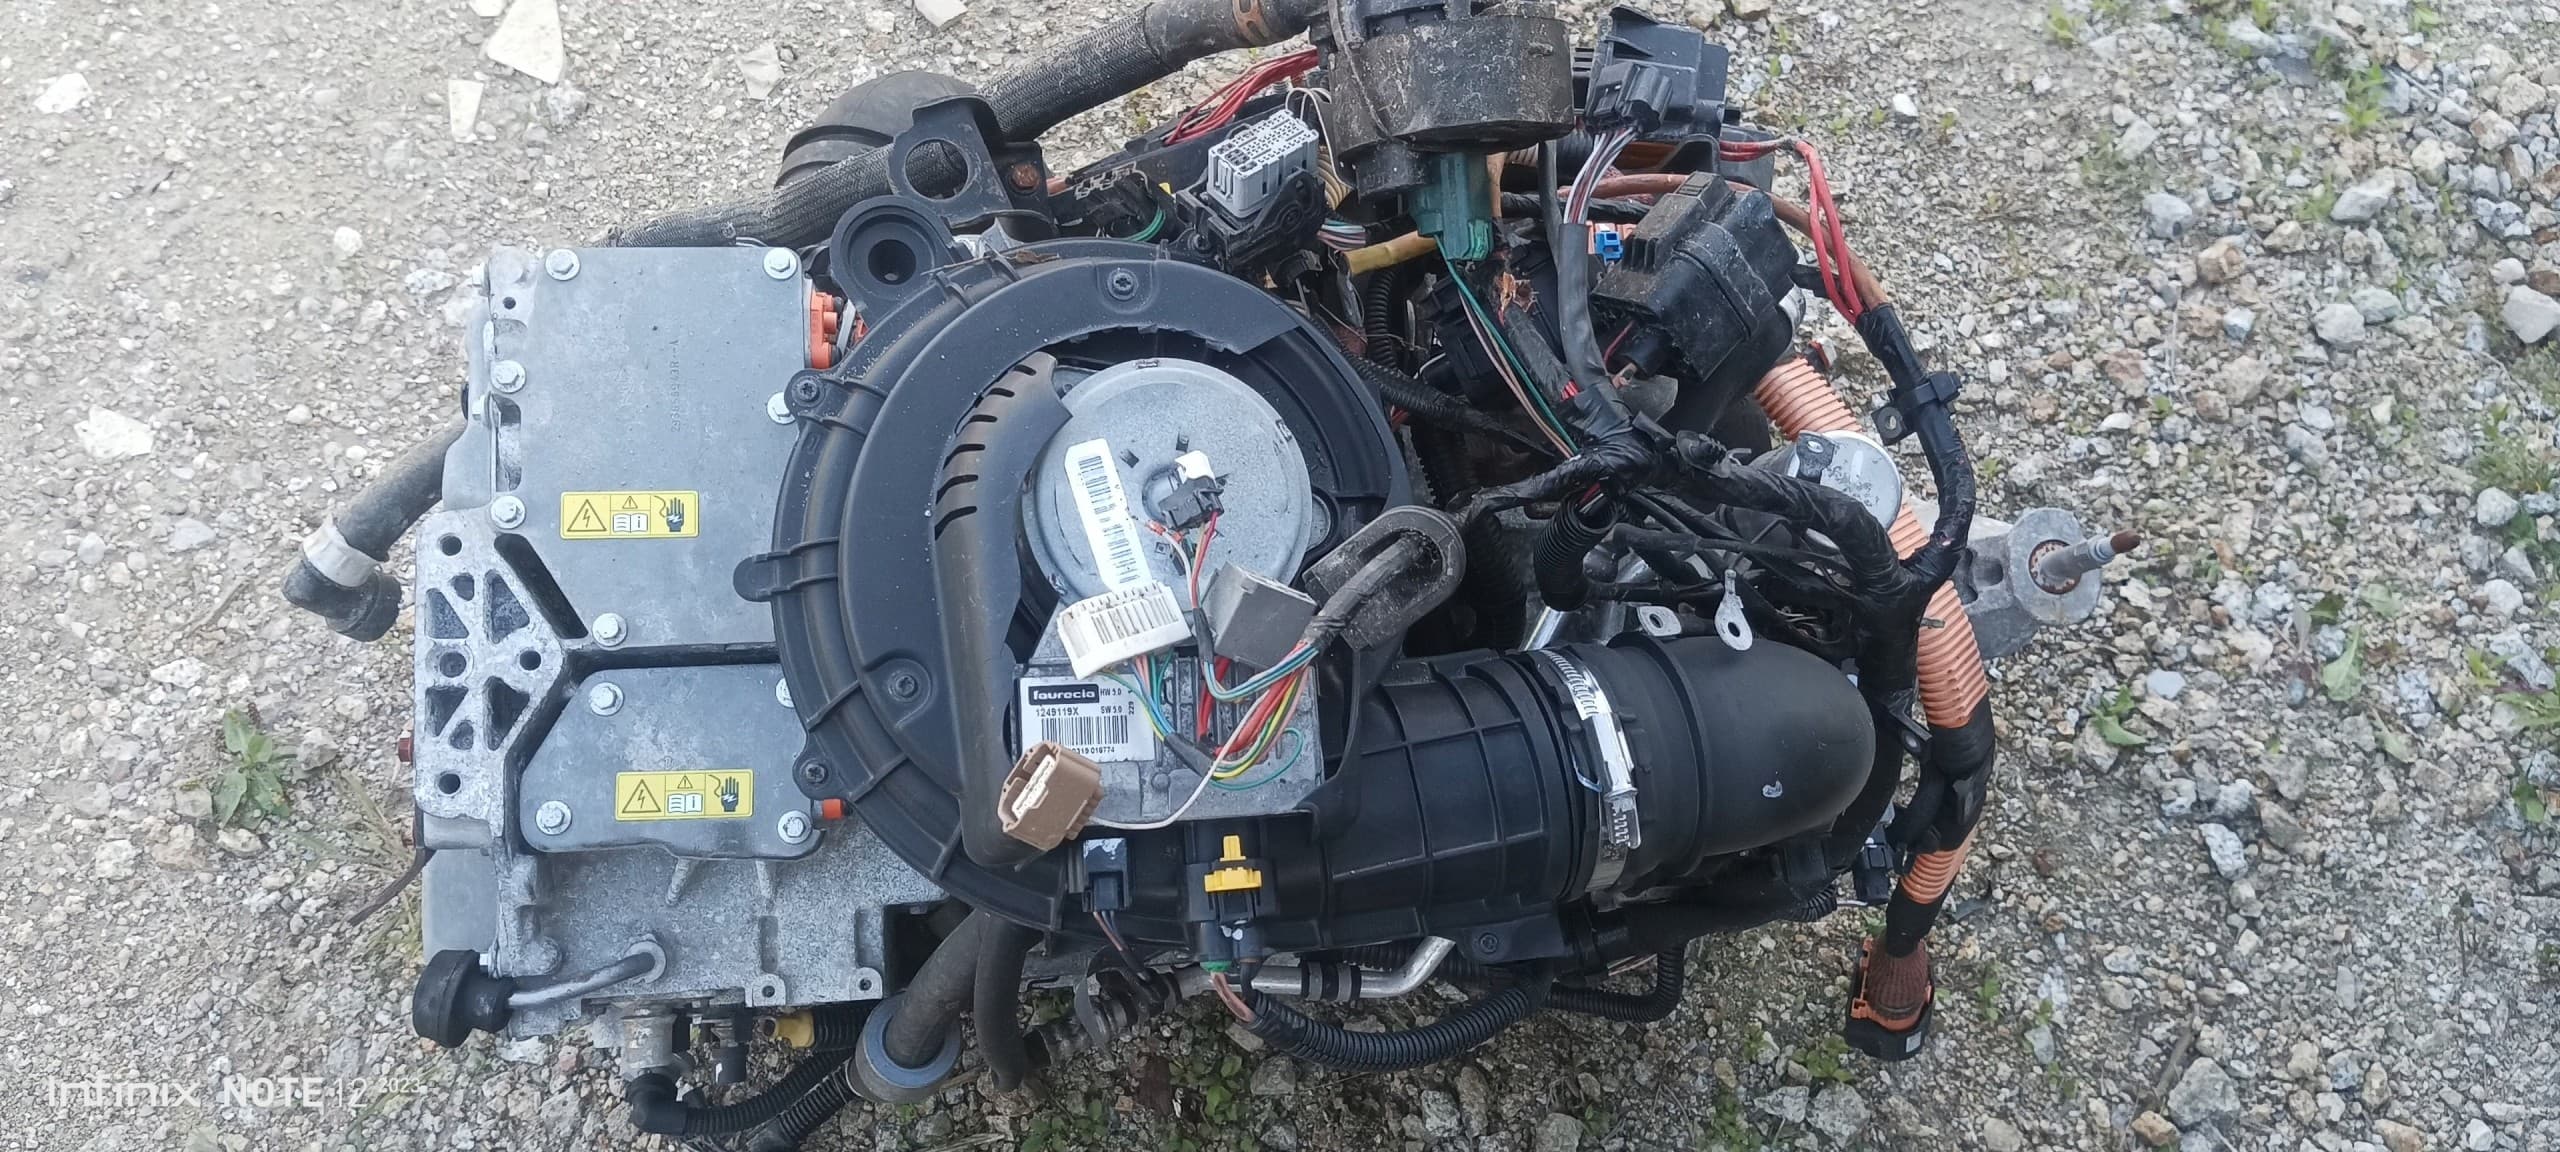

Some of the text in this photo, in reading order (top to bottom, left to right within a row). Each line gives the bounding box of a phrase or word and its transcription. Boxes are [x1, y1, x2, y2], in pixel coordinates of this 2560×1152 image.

[1033, 689, 1095, 700] faurecia
[1100, 688, 1111, 697] HW
[1100, 705, 1112, 714] SW
